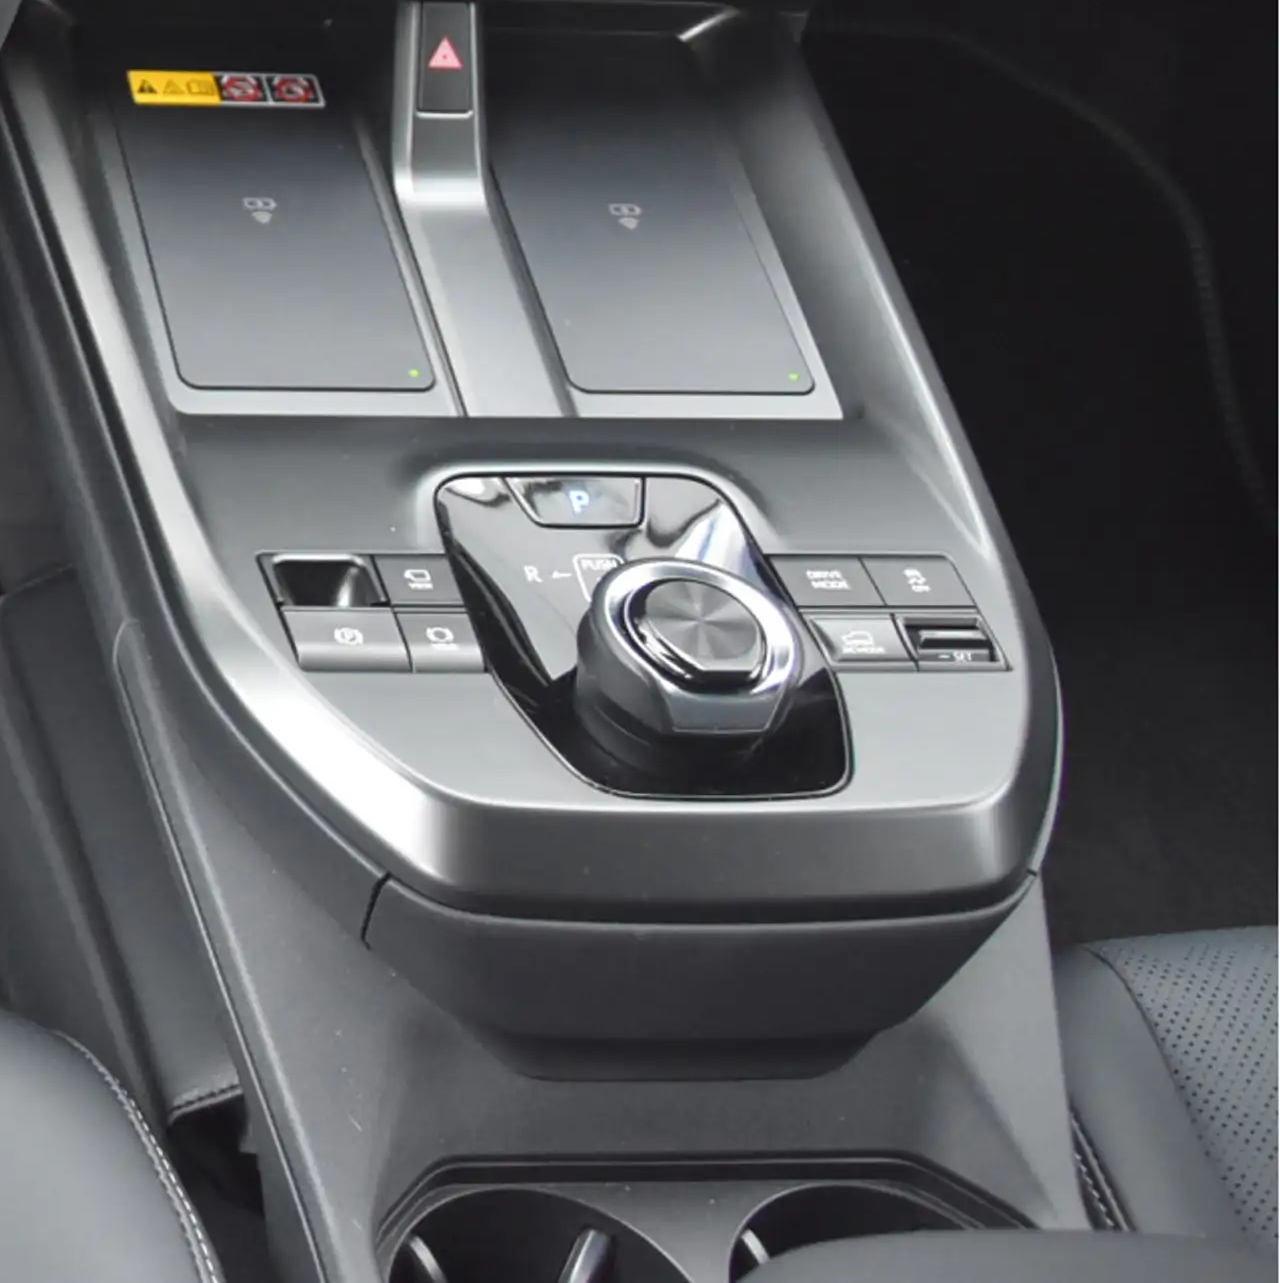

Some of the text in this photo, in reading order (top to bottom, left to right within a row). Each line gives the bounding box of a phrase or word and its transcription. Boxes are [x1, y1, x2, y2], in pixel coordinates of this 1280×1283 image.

[569, 489, 590, 513] P
[523, 564, 544, 584] R
[581, 558, 618, 571] PUSH
